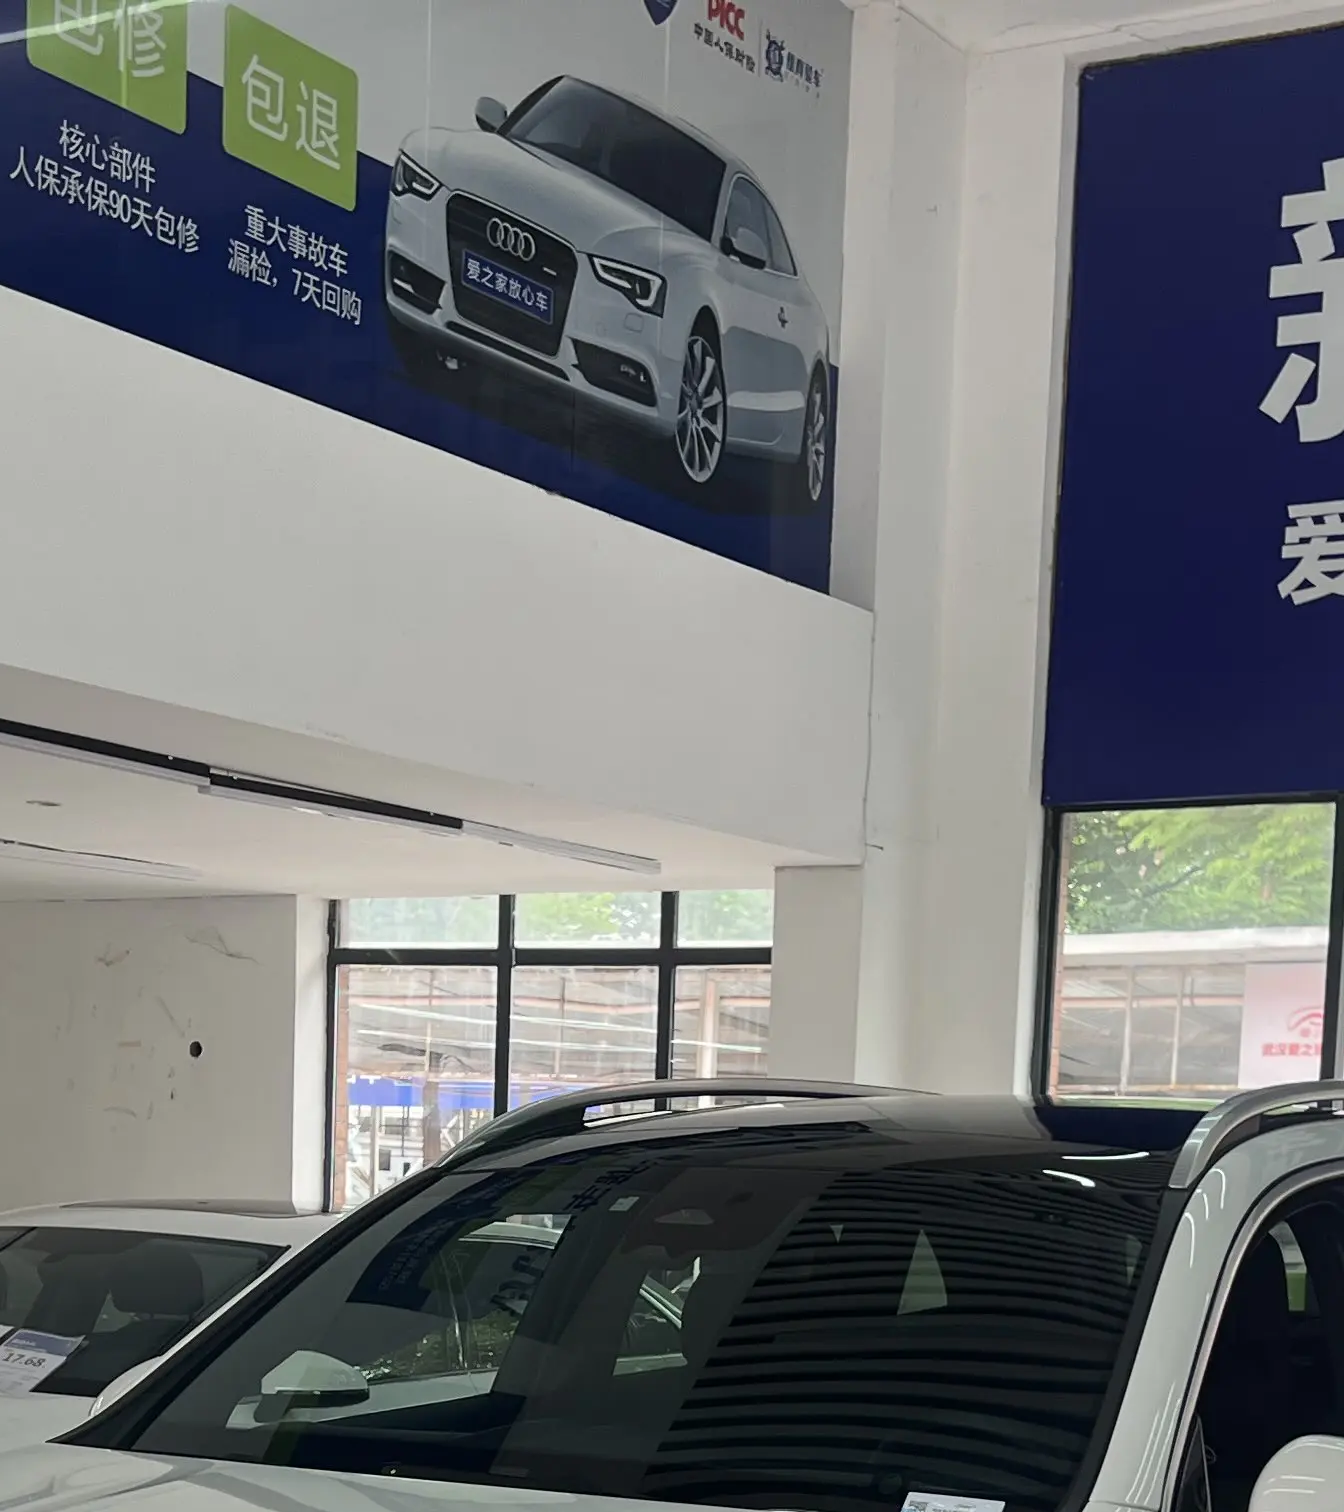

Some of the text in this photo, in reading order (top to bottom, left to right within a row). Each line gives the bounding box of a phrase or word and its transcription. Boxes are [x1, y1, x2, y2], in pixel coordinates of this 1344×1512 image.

[707, 0, 746, 41] PICC
[240, 53, 343, 171] 包退
[58, 119, 157, 193] 核心部件
[9, 145, 201, 254] 人保承保90天包修
[244, 204, 349, 277] 重大事故车
[466, 258, 549, 312] 爱之家放心车
